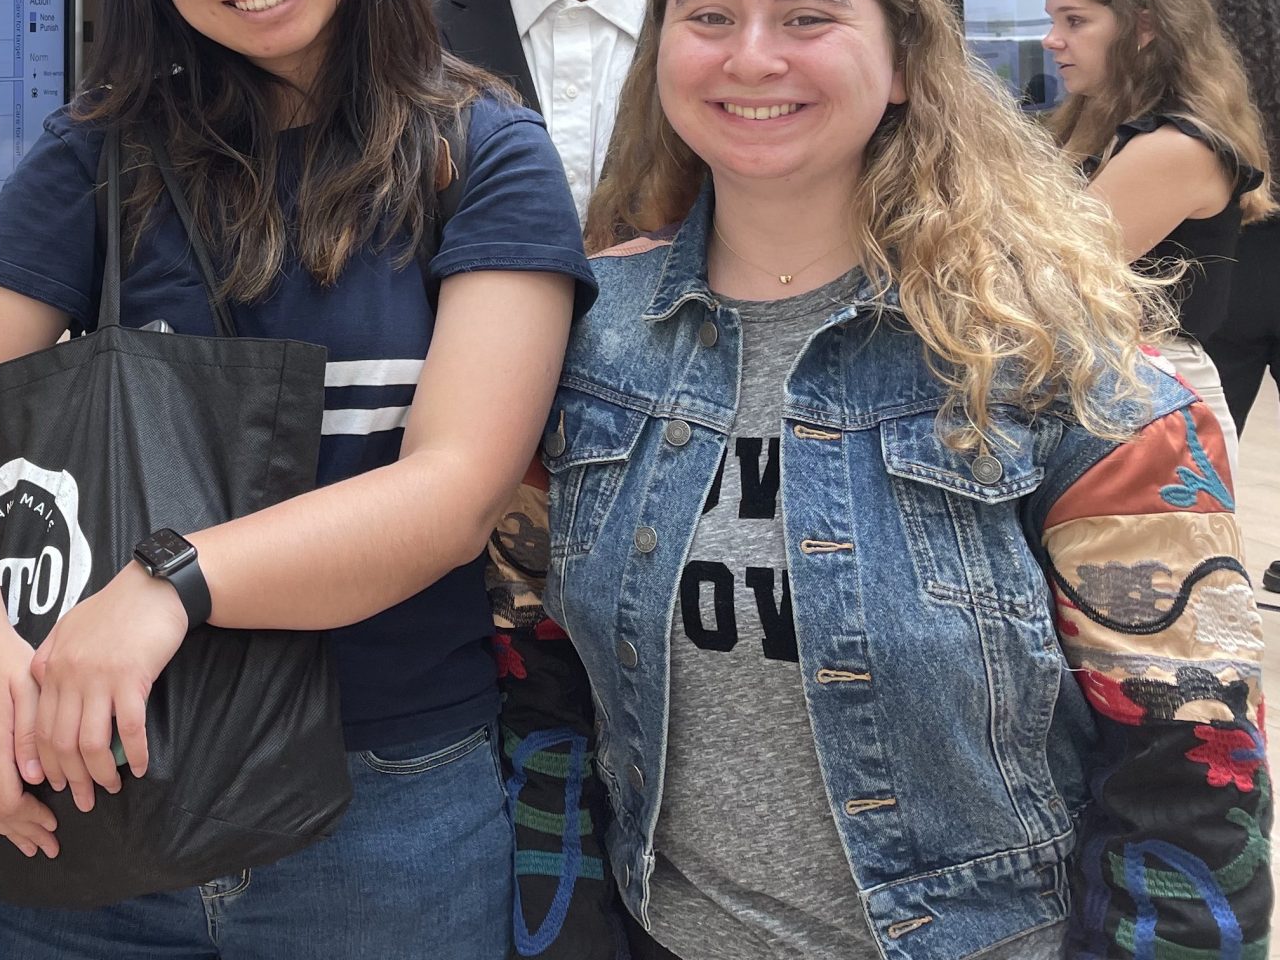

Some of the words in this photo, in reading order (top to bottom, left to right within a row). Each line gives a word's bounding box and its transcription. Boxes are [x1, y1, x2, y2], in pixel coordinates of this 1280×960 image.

[40, 13, 55, 22] None
[40, 23, 59, 32] Punish
[30, 53, 49, 62] Norm
